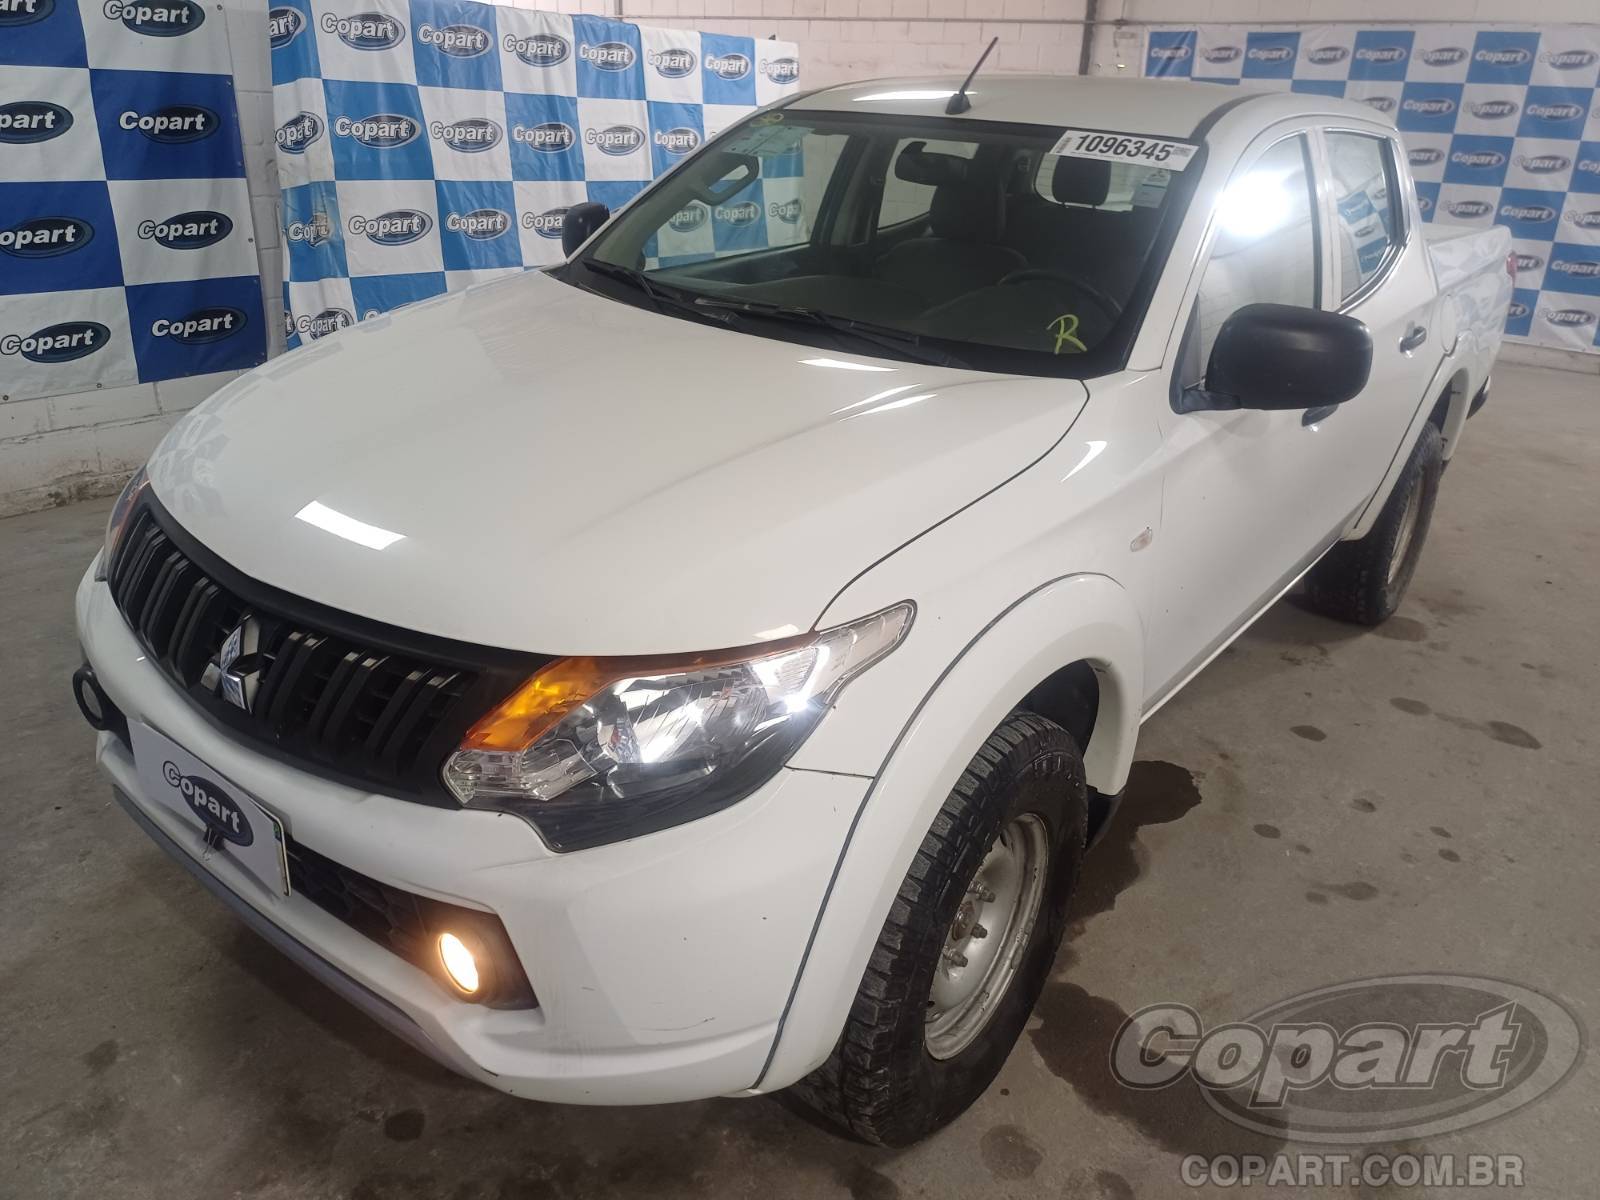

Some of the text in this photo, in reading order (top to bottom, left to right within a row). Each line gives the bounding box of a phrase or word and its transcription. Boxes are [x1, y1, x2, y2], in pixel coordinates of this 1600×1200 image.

[103, 0, 191, 24] Copart
[321, 13, 395, 38] Copart
[418, 25, 483, 48] Copart
[503, 34, 562, 56] Copart
[580, 44, 630, 64] Copart
[647, 49, 690, 70] Copart
[705, 54, 745, 73] Copart
[1355, 48, 1400, 61] Copart
[1475, 49, 1525, 63] Copart
[759, 59, 798, 77] Copart
[1403, 99, 1449, 113] Copart
[1527, 103, 1578, 117] Copart
[0, 111, 55, 129] part
[119, 111, 206, 132] Copart
[335, 116, 410, 139] Copart
[431, 121, 493, 143] Copart
[513, 126, 569, 145] Copart
[585, 129, 638, 147] Copart
[655, 131, 695, 149] Copart
[1075, 135, 1175, 162] 1096345
[1452, 151, 1500, 166] Copart
[715, 205, 754, 222] Copart
[1501, 203, 1550, 218] Copart
[138, 219, 219, 242] Copart
[349, 215, 421, 236] Copart
[446, 212, 504, 233] Copart
[522, 212, 564, 232] Copa
[0, 224, 76, 249] opart
[1551, 259, 1600, 275] Copart
[151, 313, 234, 341] Copart
[297, 313, 346, 334] Copart
[1046, 313, 1088, 355] R
[0, 329, 94, 356] Copart
[163, 760, 241, 833] Copart
